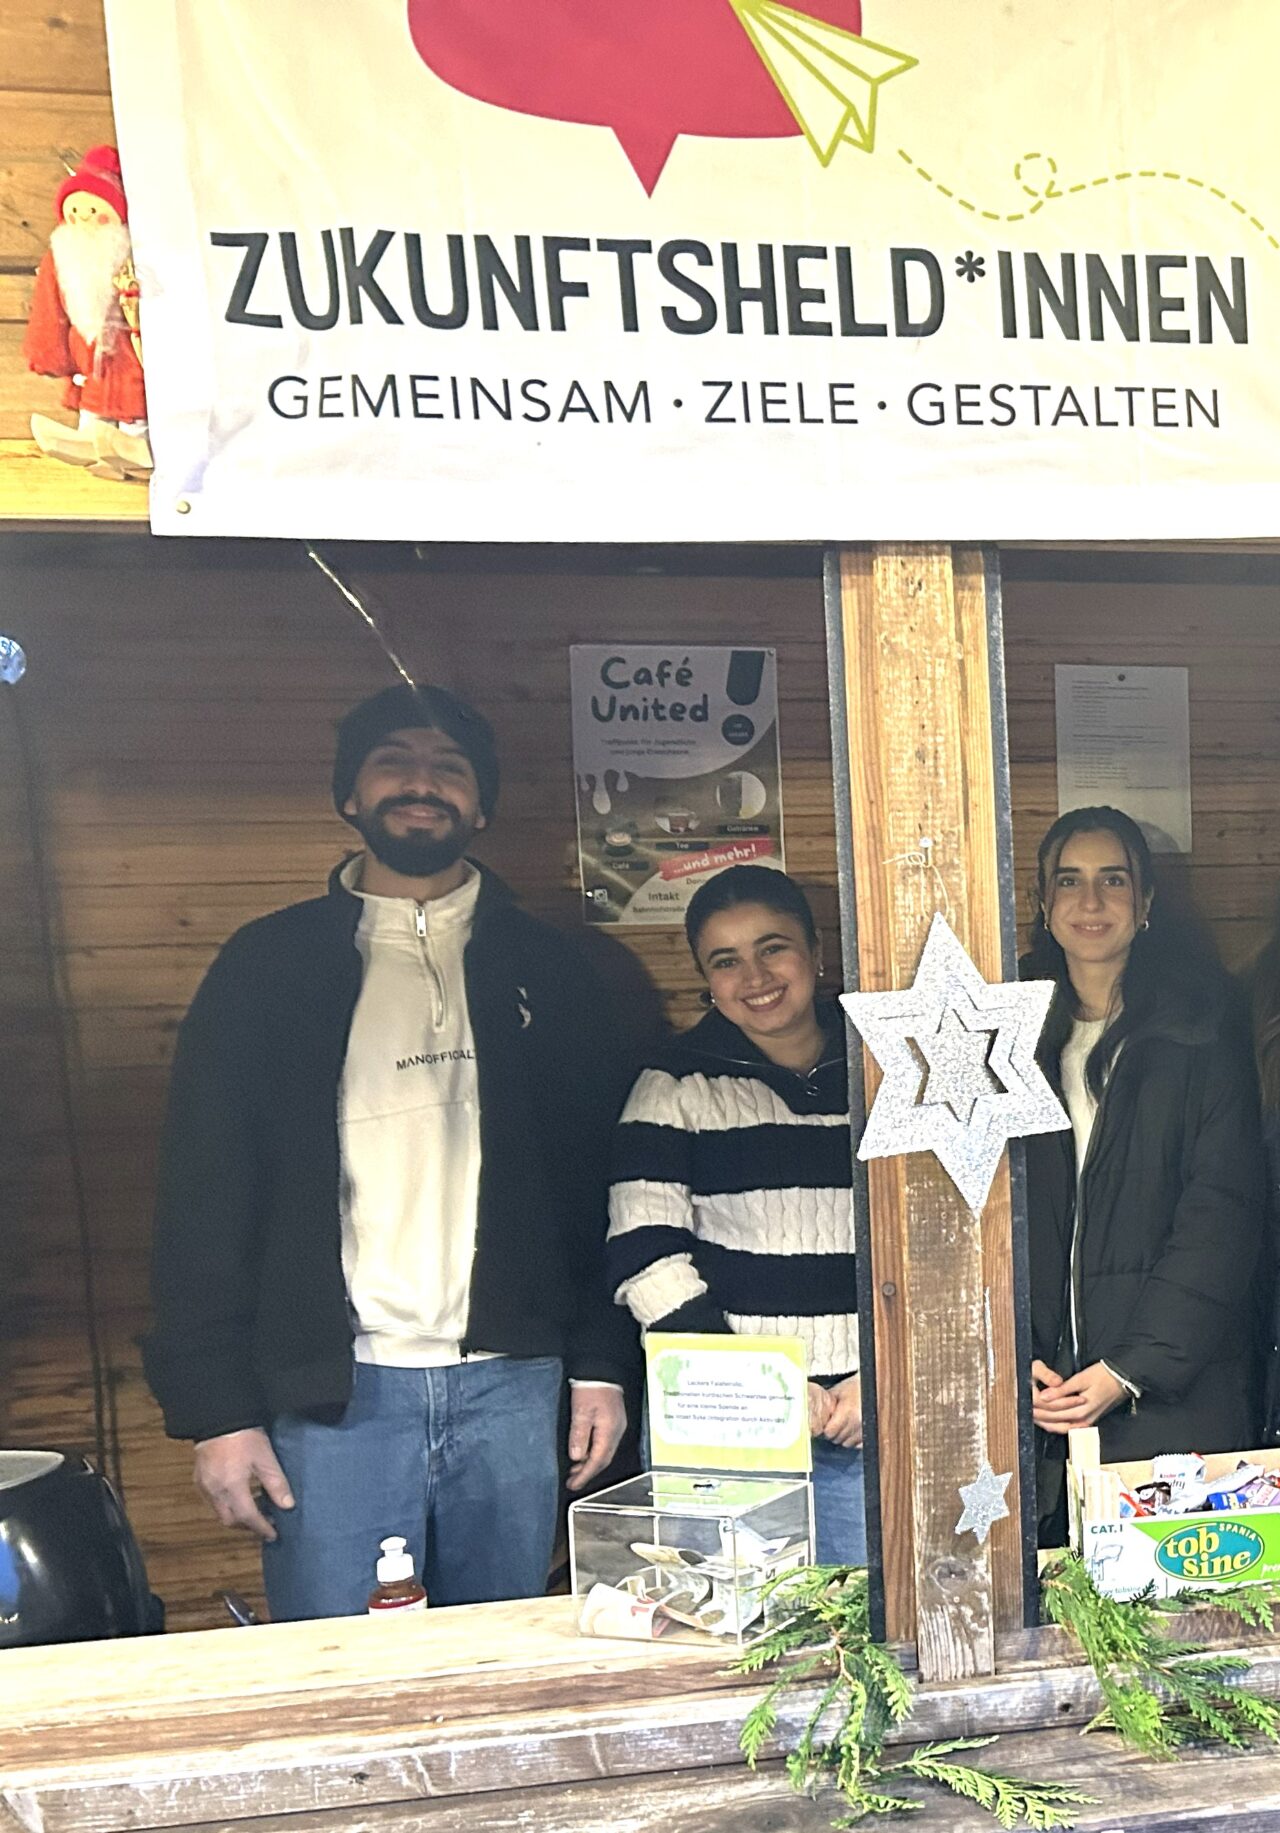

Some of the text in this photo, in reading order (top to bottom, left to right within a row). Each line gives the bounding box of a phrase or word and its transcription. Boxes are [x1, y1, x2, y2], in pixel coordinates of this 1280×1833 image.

[267, 374, 1221, 428] GEMEINSAM ZIELE GESTALTEN
[600, 655, 694, 690] Café
[591, 693, 710, 723] United
[713, 843, 757, 865] mehr!
[1091, 1525, 1117, 1535] CAT.
[1165, 1526, 1220, 1559] tob
[1218, 1522, 1258, 1541] SPANIA
[1183, 1550, 1251, 1578] sine
